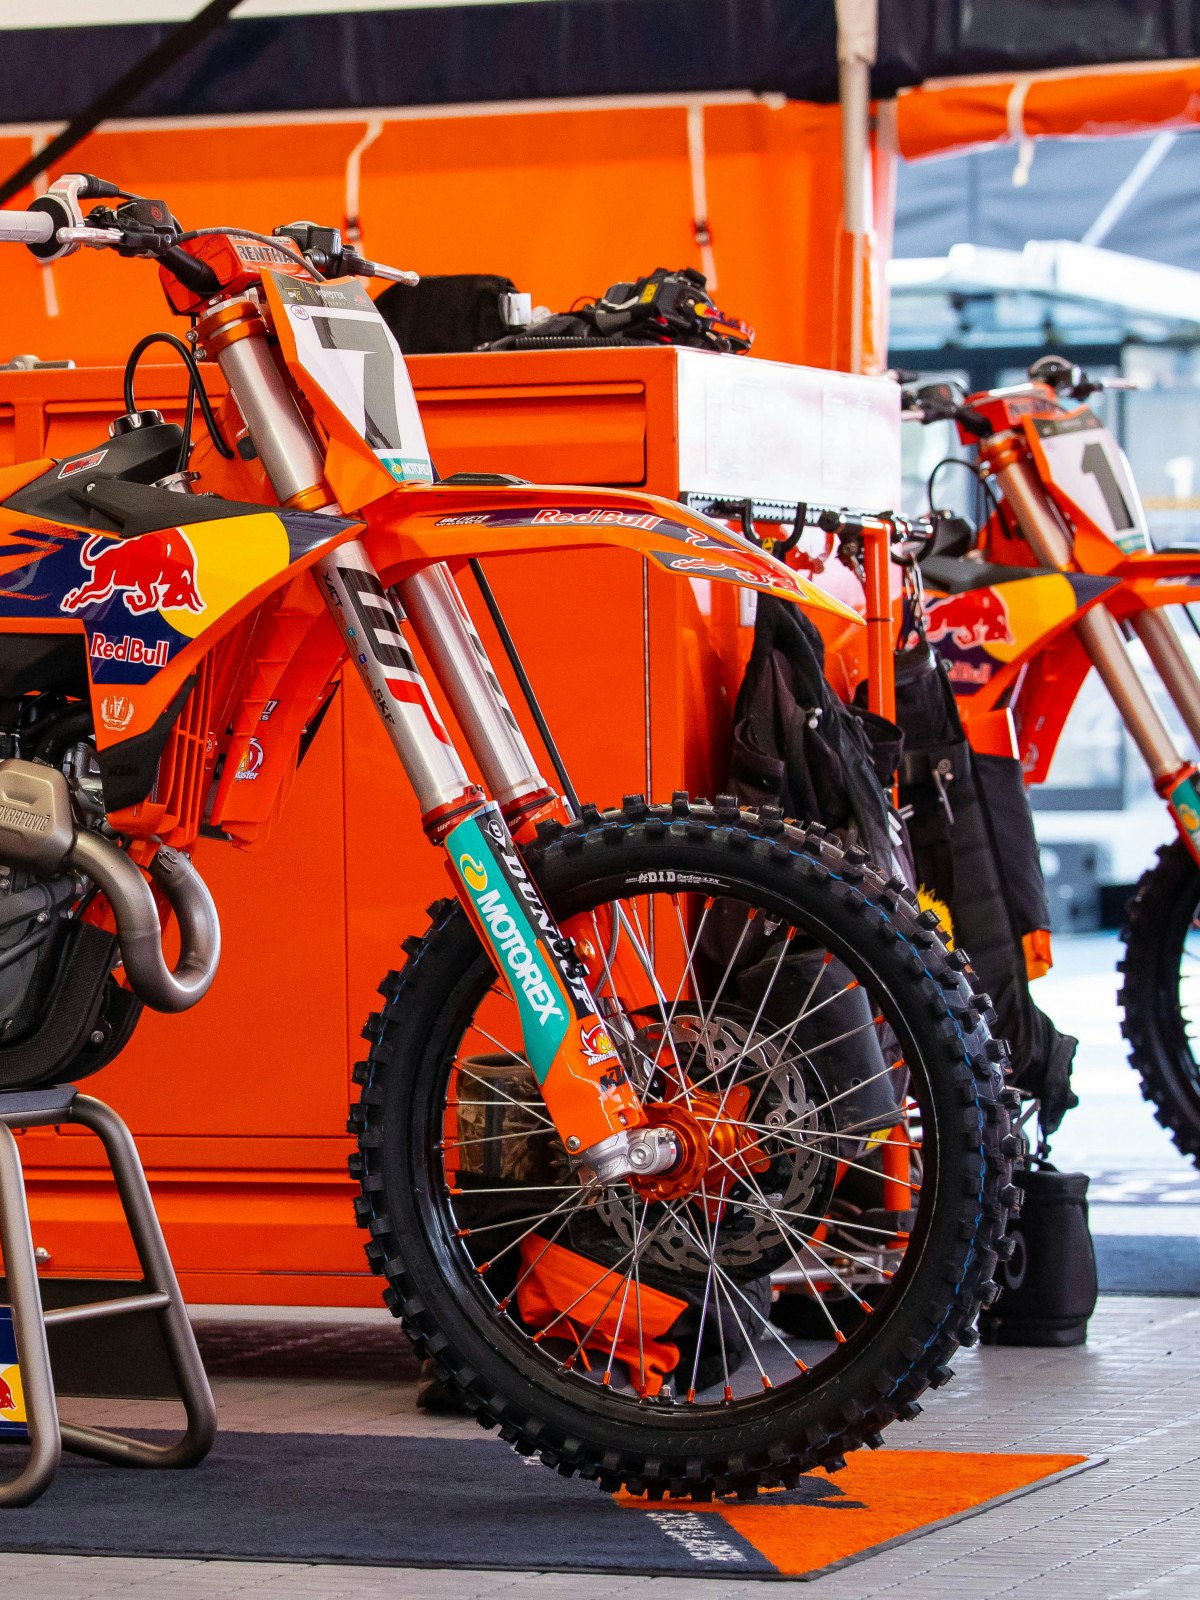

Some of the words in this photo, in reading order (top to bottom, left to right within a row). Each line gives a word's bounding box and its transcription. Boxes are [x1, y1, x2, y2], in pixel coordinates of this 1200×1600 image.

[236, 245, 300, 264] RENTHA
[311, 316, 402, 450] 7
[1081, 442, 1135, 531] 1
[322, 571, 343, 608] XACT
[374, 688, 396, 725] SKF
[477, 889, 564, 1027] MOTOREX
[600, 1064, 627, 1092] KT
